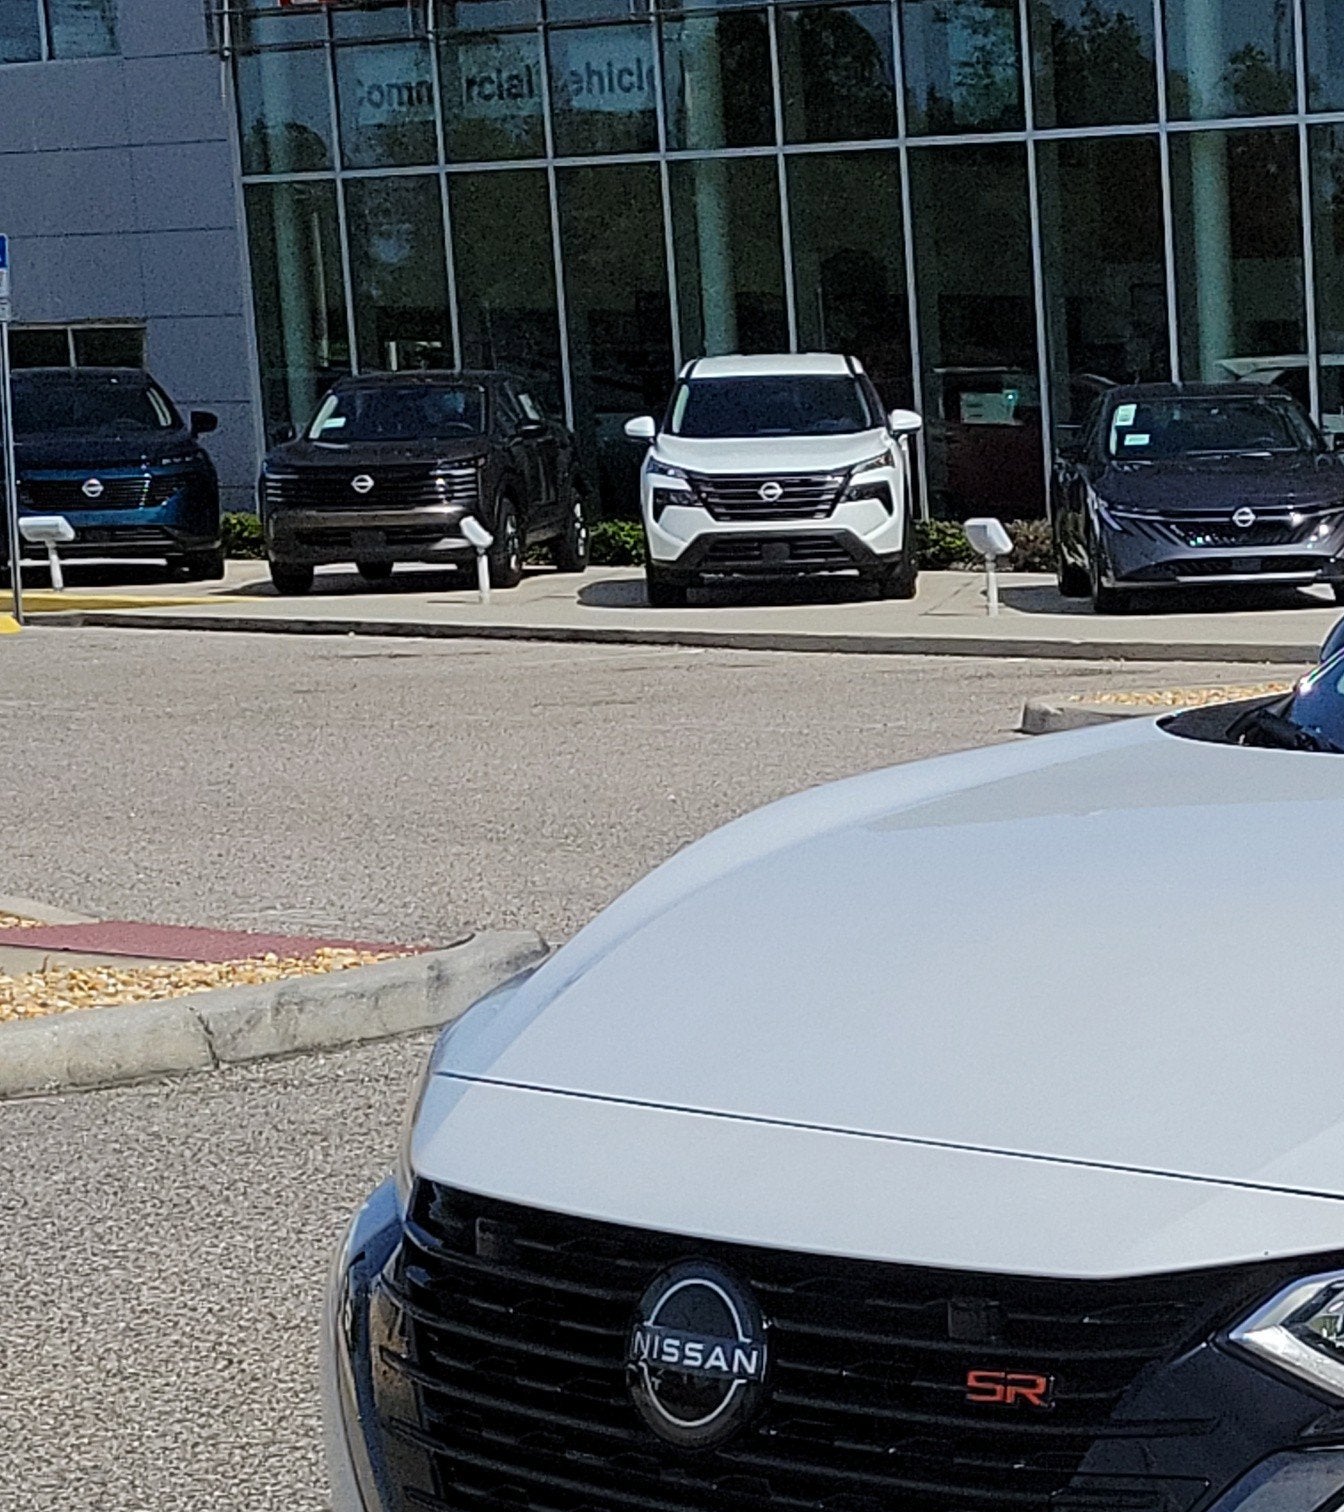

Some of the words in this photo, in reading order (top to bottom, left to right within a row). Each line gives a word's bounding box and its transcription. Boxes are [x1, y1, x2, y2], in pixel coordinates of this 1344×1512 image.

[356, 63, 536, 109] ommrcial
[564, 56, 656, 98] ehicl
[633, 1330, 759, 1375] NISSAN
[966, 1370, 1047, 1407] SR
